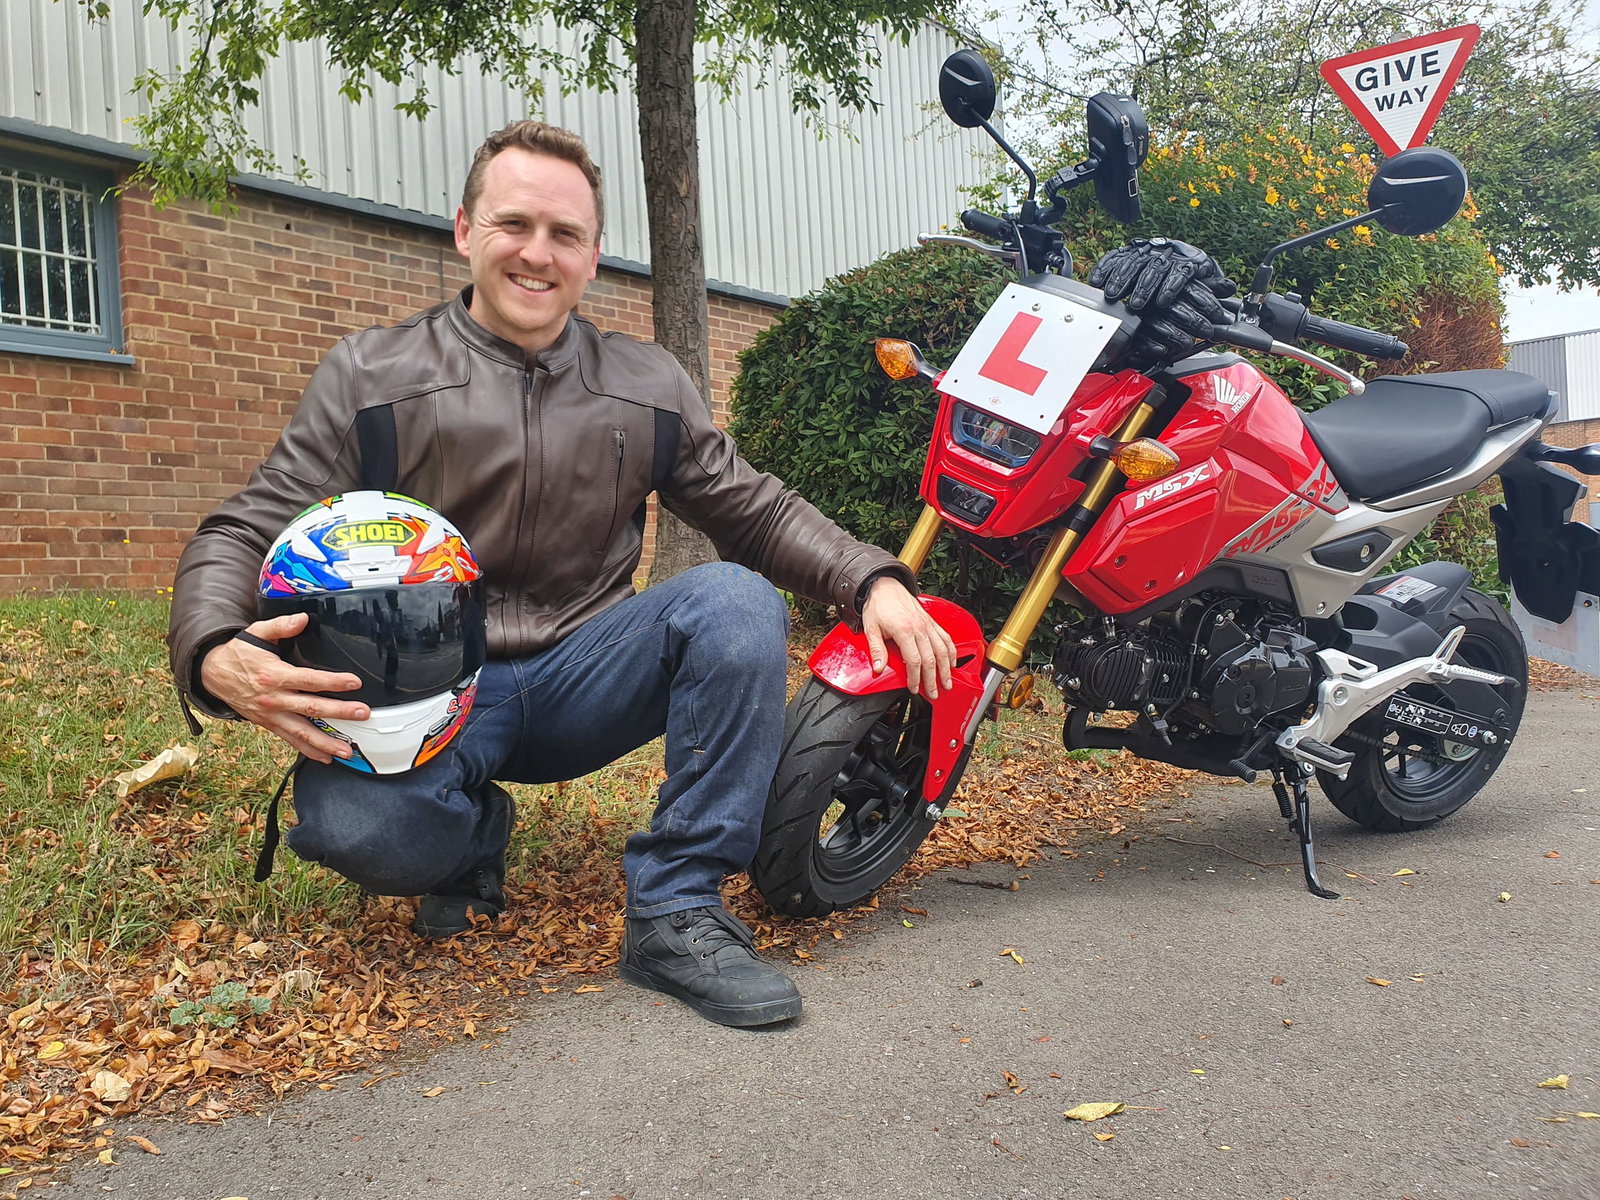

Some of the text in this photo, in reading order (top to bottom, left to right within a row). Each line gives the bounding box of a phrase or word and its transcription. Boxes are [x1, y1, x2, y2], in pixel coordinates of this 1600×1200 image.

[1355, 50, 1440, 92] GIVE
[1374, 85, 1429, 112] WAY
[978, 311, 1048, 396] L
[1231, 391, 1252, 414] HONDA
[1134, 464, 1210, 510] MSX
[335, 524, 405, 547] SHOEI
